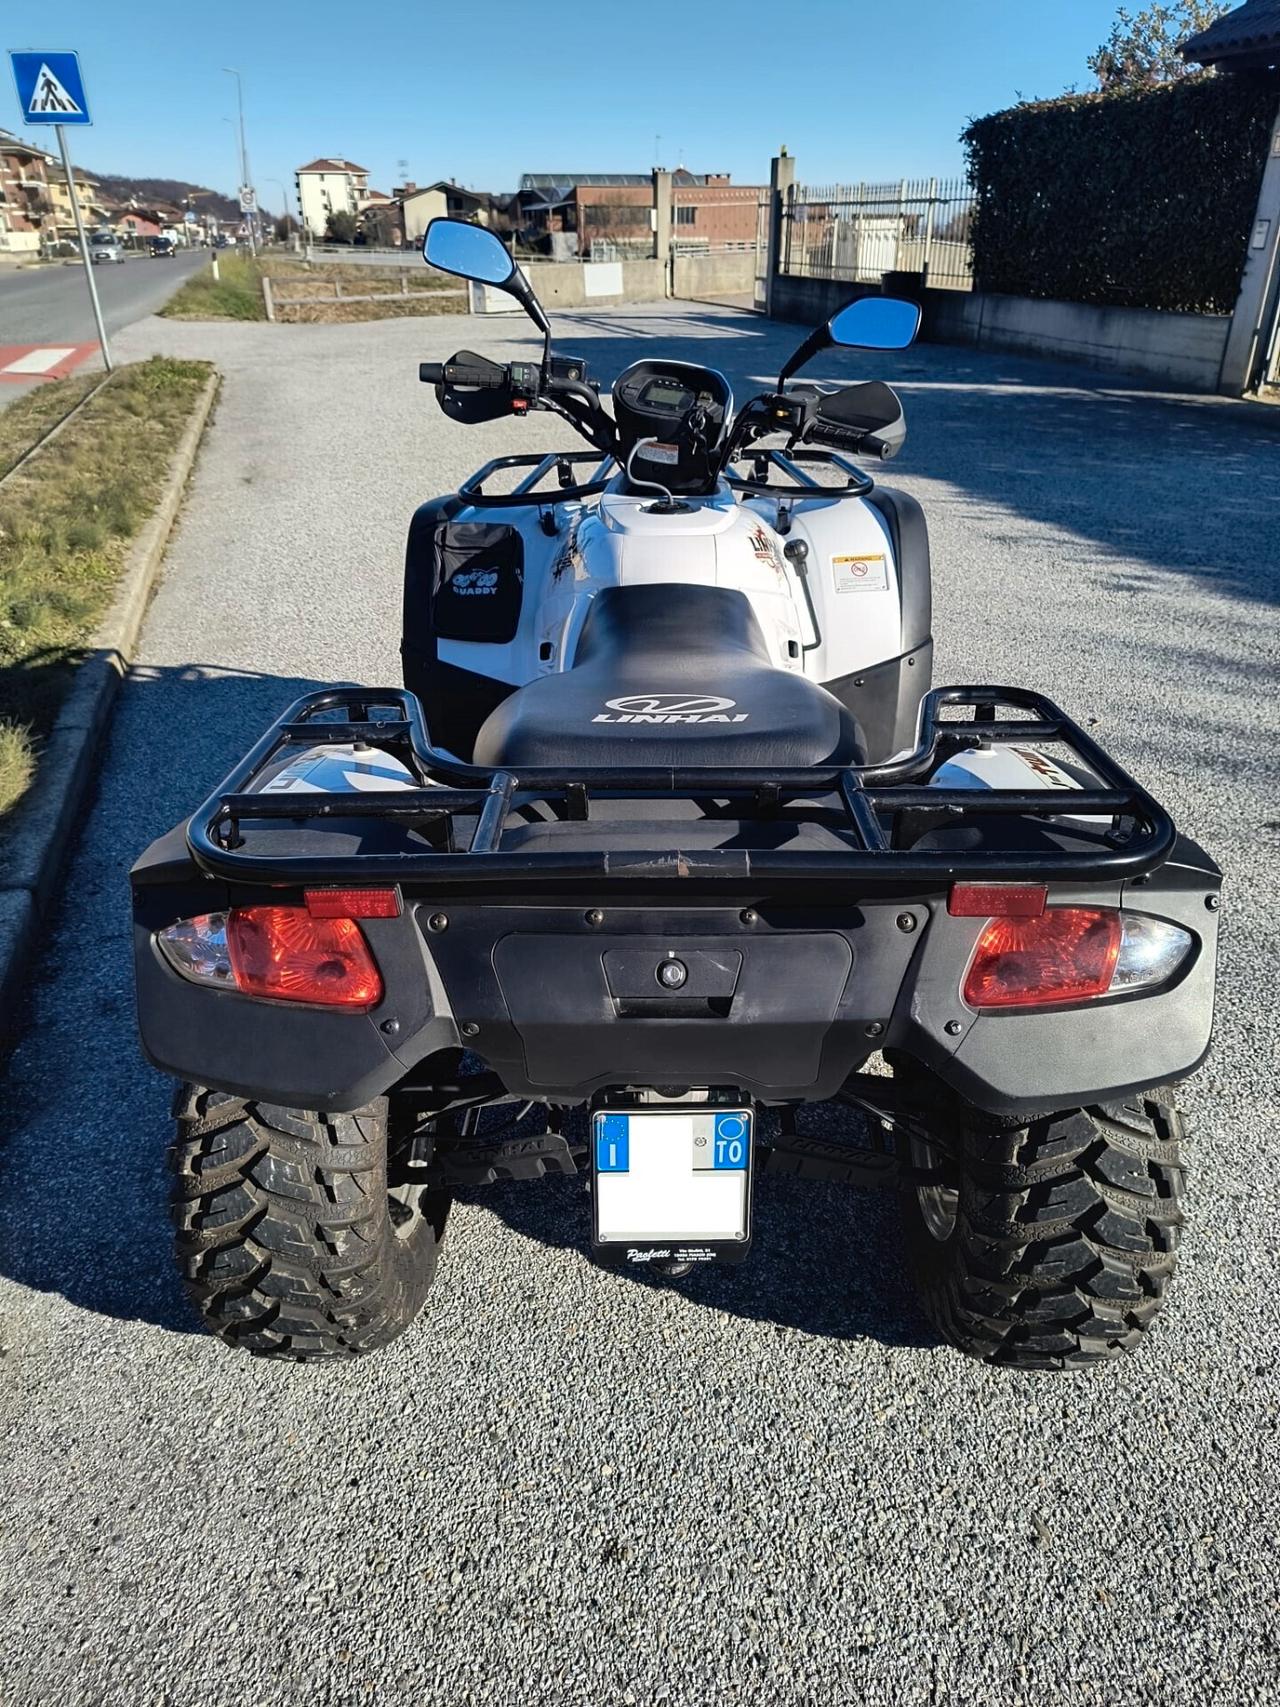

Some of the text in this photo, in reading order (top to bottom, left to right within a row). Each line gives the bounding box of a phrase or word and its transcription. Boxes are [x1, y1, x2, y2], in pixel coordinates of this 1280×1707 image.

[591, 713, 749, 723] LINHAI
[609, 1143, 616, 1167] I
[716, 1140, 742, 1163] TO
